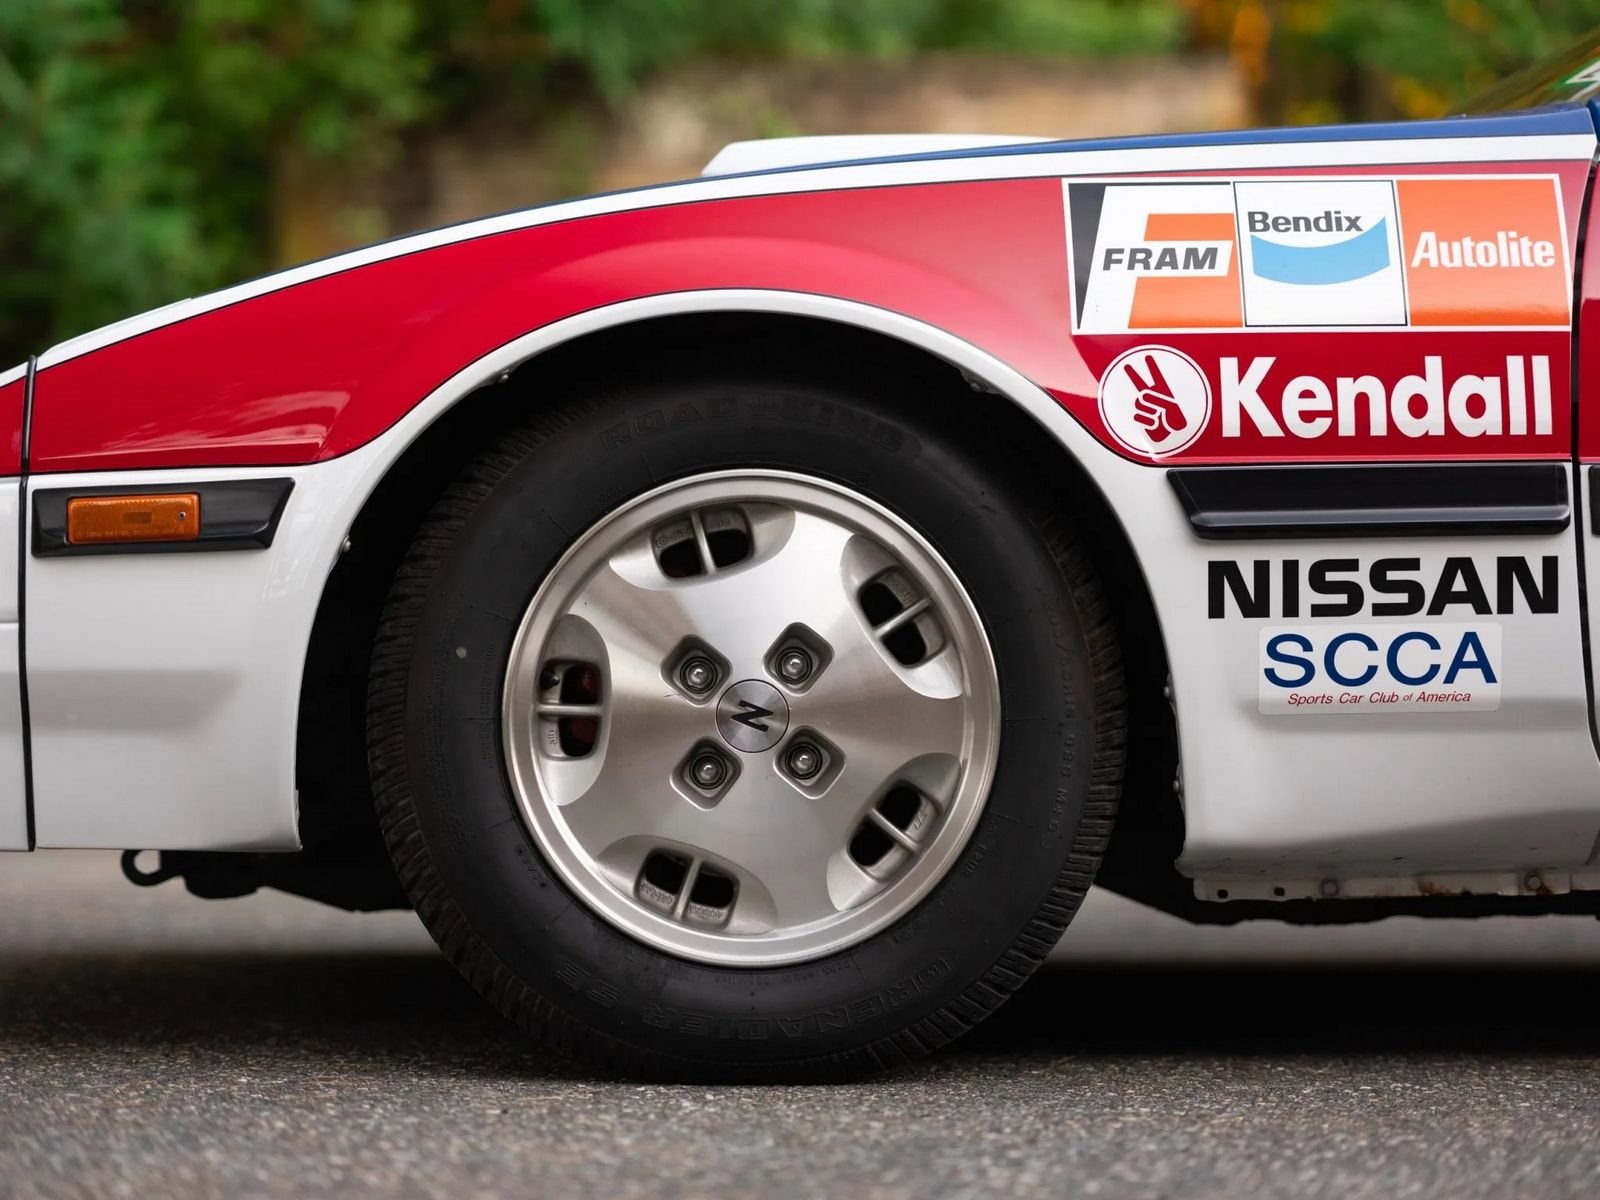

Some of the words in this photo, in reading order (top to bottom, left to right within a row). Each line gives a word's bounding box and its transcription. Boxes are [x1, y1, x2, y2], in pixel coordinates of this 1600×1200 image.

[1247, 210, 1364, 234] Bendix
[1102, 246, 1219, 271] FRAM
[1411, 231, 1556, 269] Autolite
[1219, 355, 1553, 439] Kendall
[1207, 555, 1559, 620] NISSAN
[1263, 631, 1498, 688] SCCA
[1287, 692, 1333, 707] Sports
[1338, 692, 1364, 705] Car
[1368, 691, 1399, 704] Club
[1402, 693, 1413, 702] of
[1416, 690, 1472, 703] America
